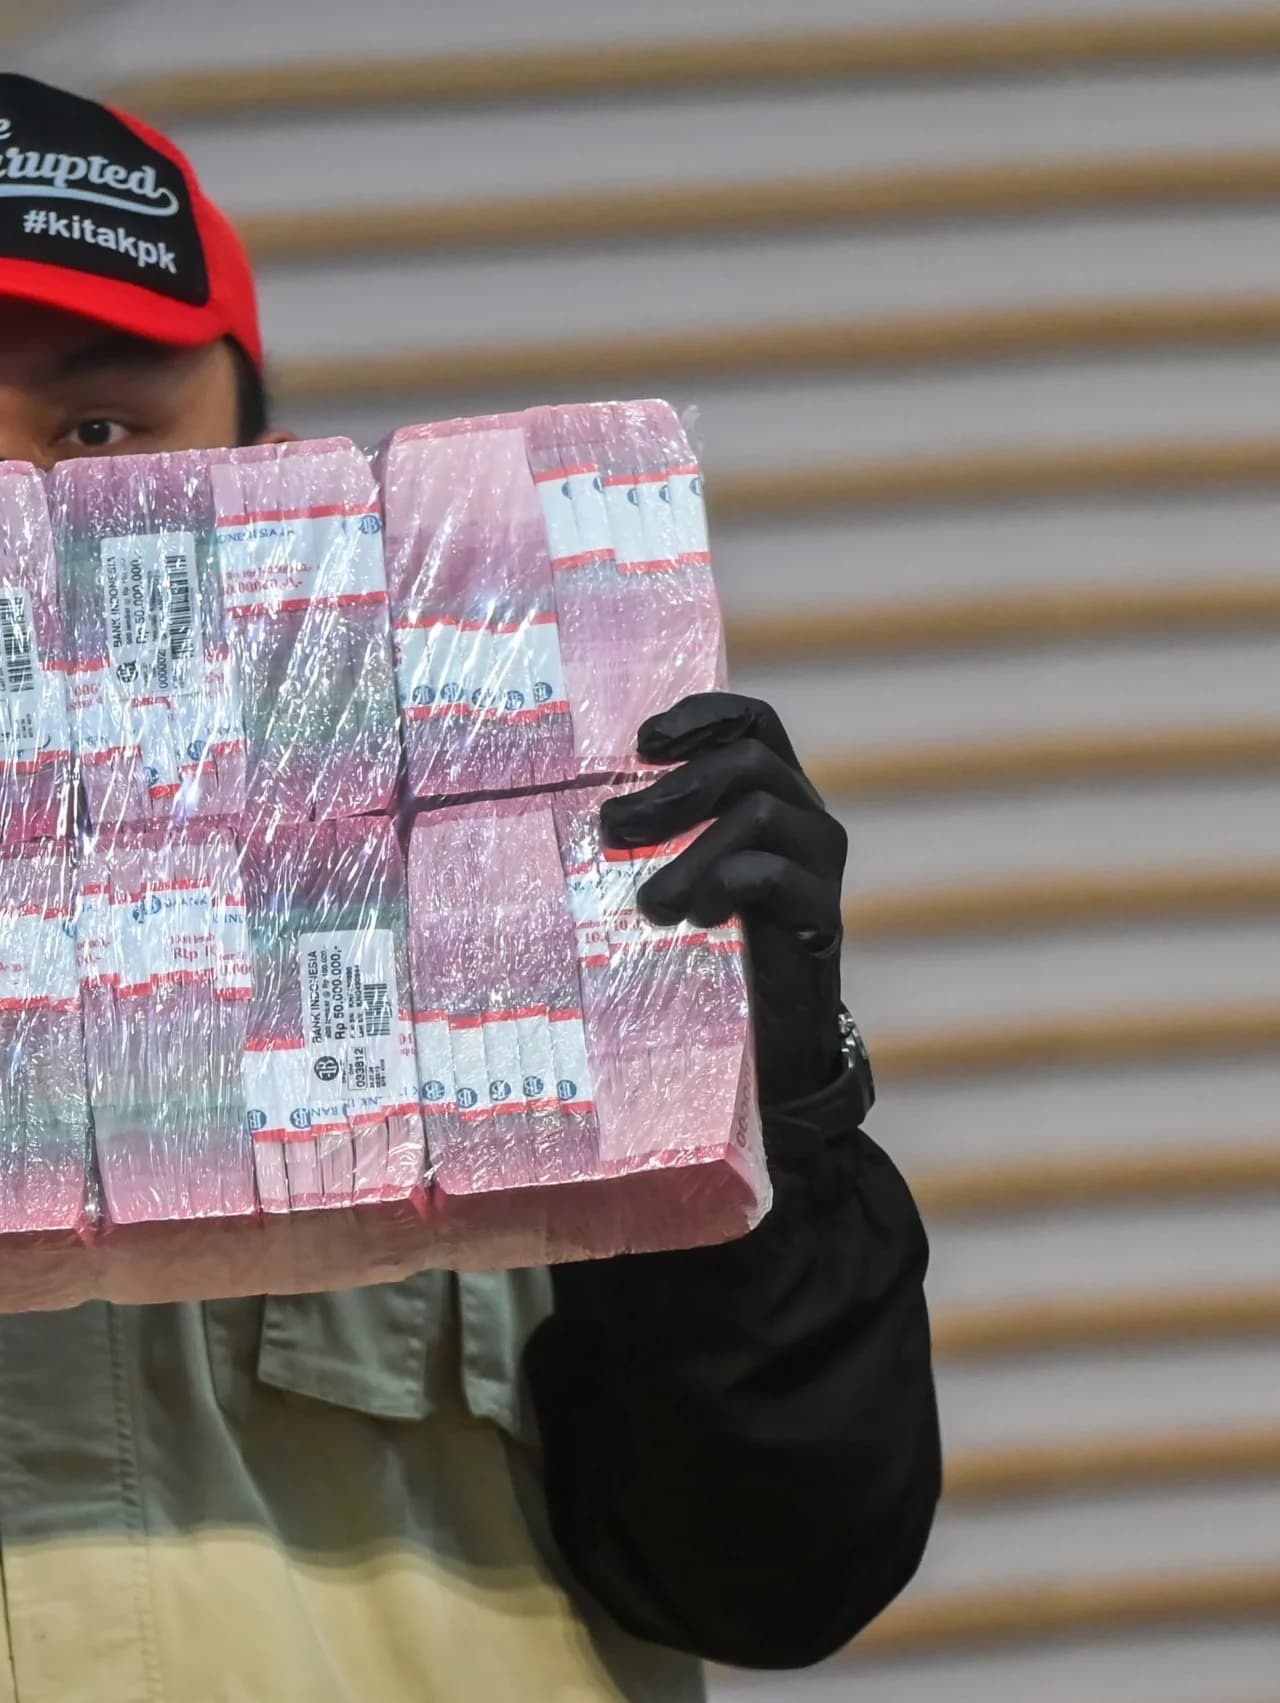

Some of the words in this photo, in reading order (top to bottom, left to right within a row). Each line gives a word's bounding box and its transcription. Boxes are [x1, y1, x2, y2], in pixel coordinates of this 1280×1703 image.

[23, 209, 177, 274] #kitakpk
[107, 556, 121, 615] INDONESIA
[112, 618, 122, 647] BANK
[136, 627, 149, 644] Rp
[308, 951, 320, 1010] INDONESIA
[331, 945, 344, 1018] 50.000.000,-
[311, 1013, 322, 1043] BANK
[334, 1022, 346, 1039] Rp
